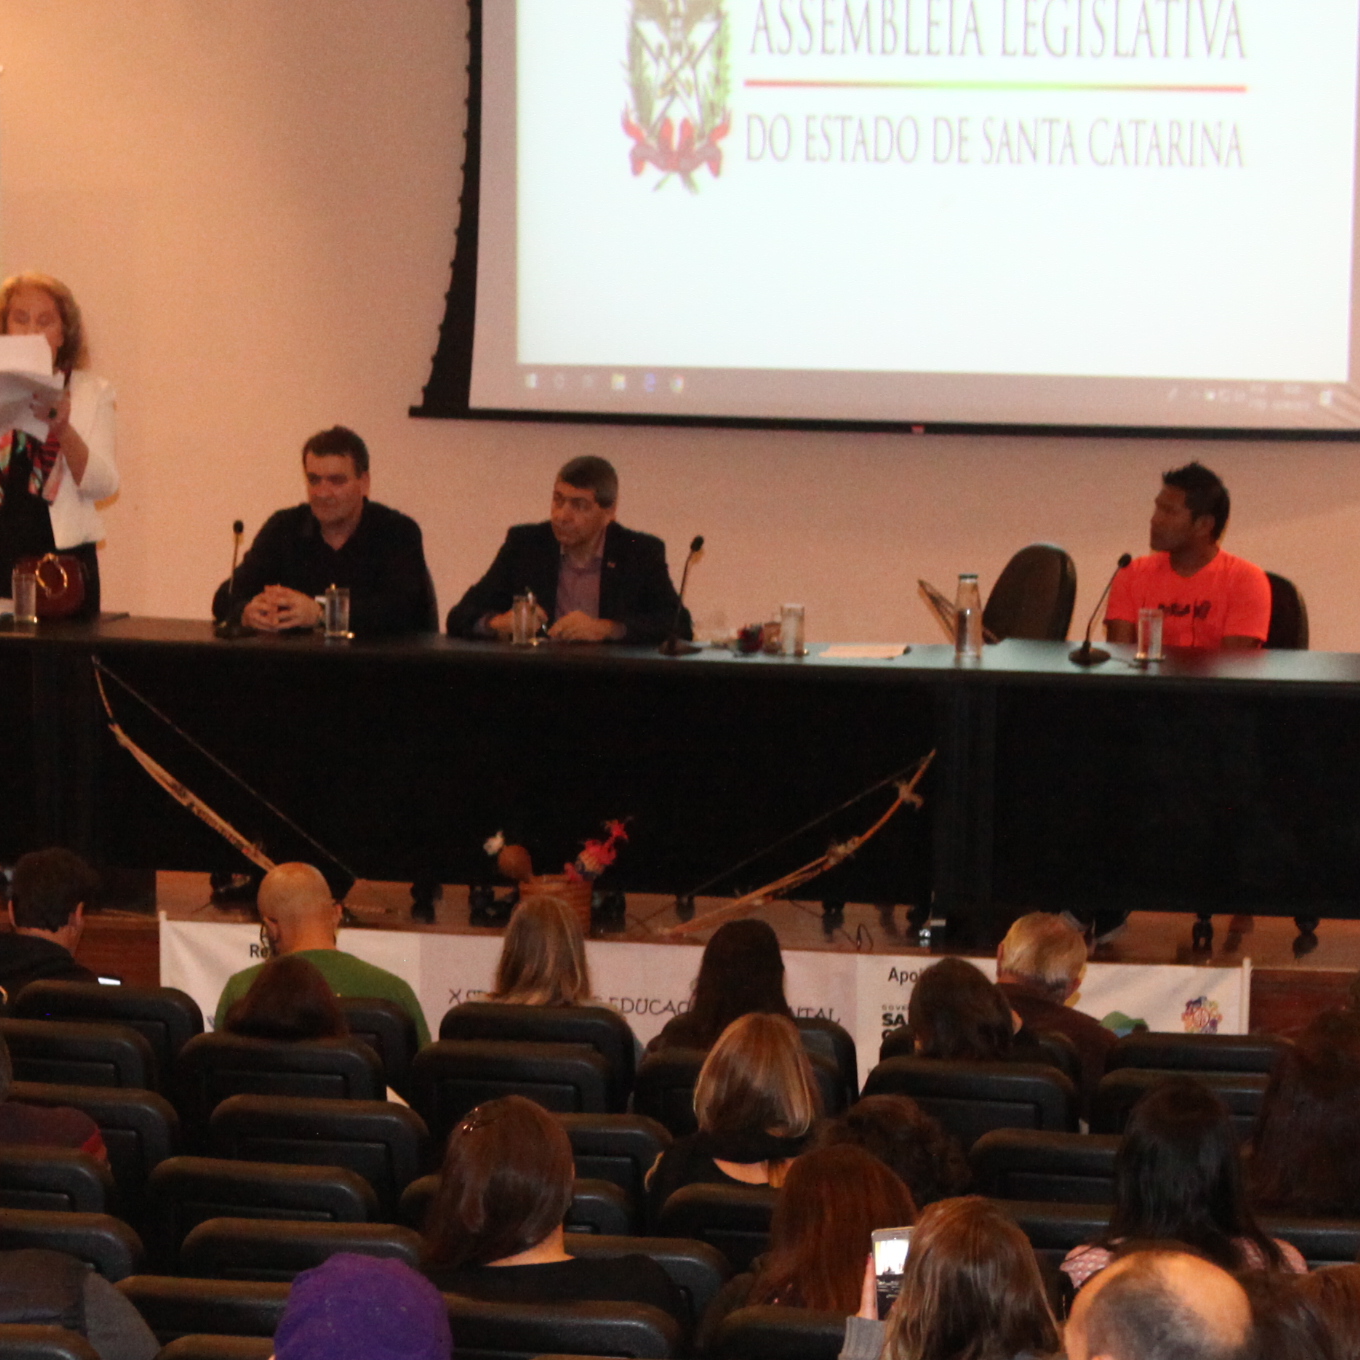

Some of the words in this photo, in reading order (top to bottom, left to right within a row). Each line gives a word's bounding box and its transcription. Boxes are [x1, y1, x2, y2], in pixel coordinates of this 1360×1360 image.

[1001, 0, 1247, 59] LEGISLATIVA
[745, 113, 791, 162] DO
[803, 114, 920, 164] ESTADO
[931, 116, 971, 164] DE
[981, 116, 1078, 166] SANTA
[1088, 118, 1244, 168] CATARINA
[888, 966, 921, 986] Apo
